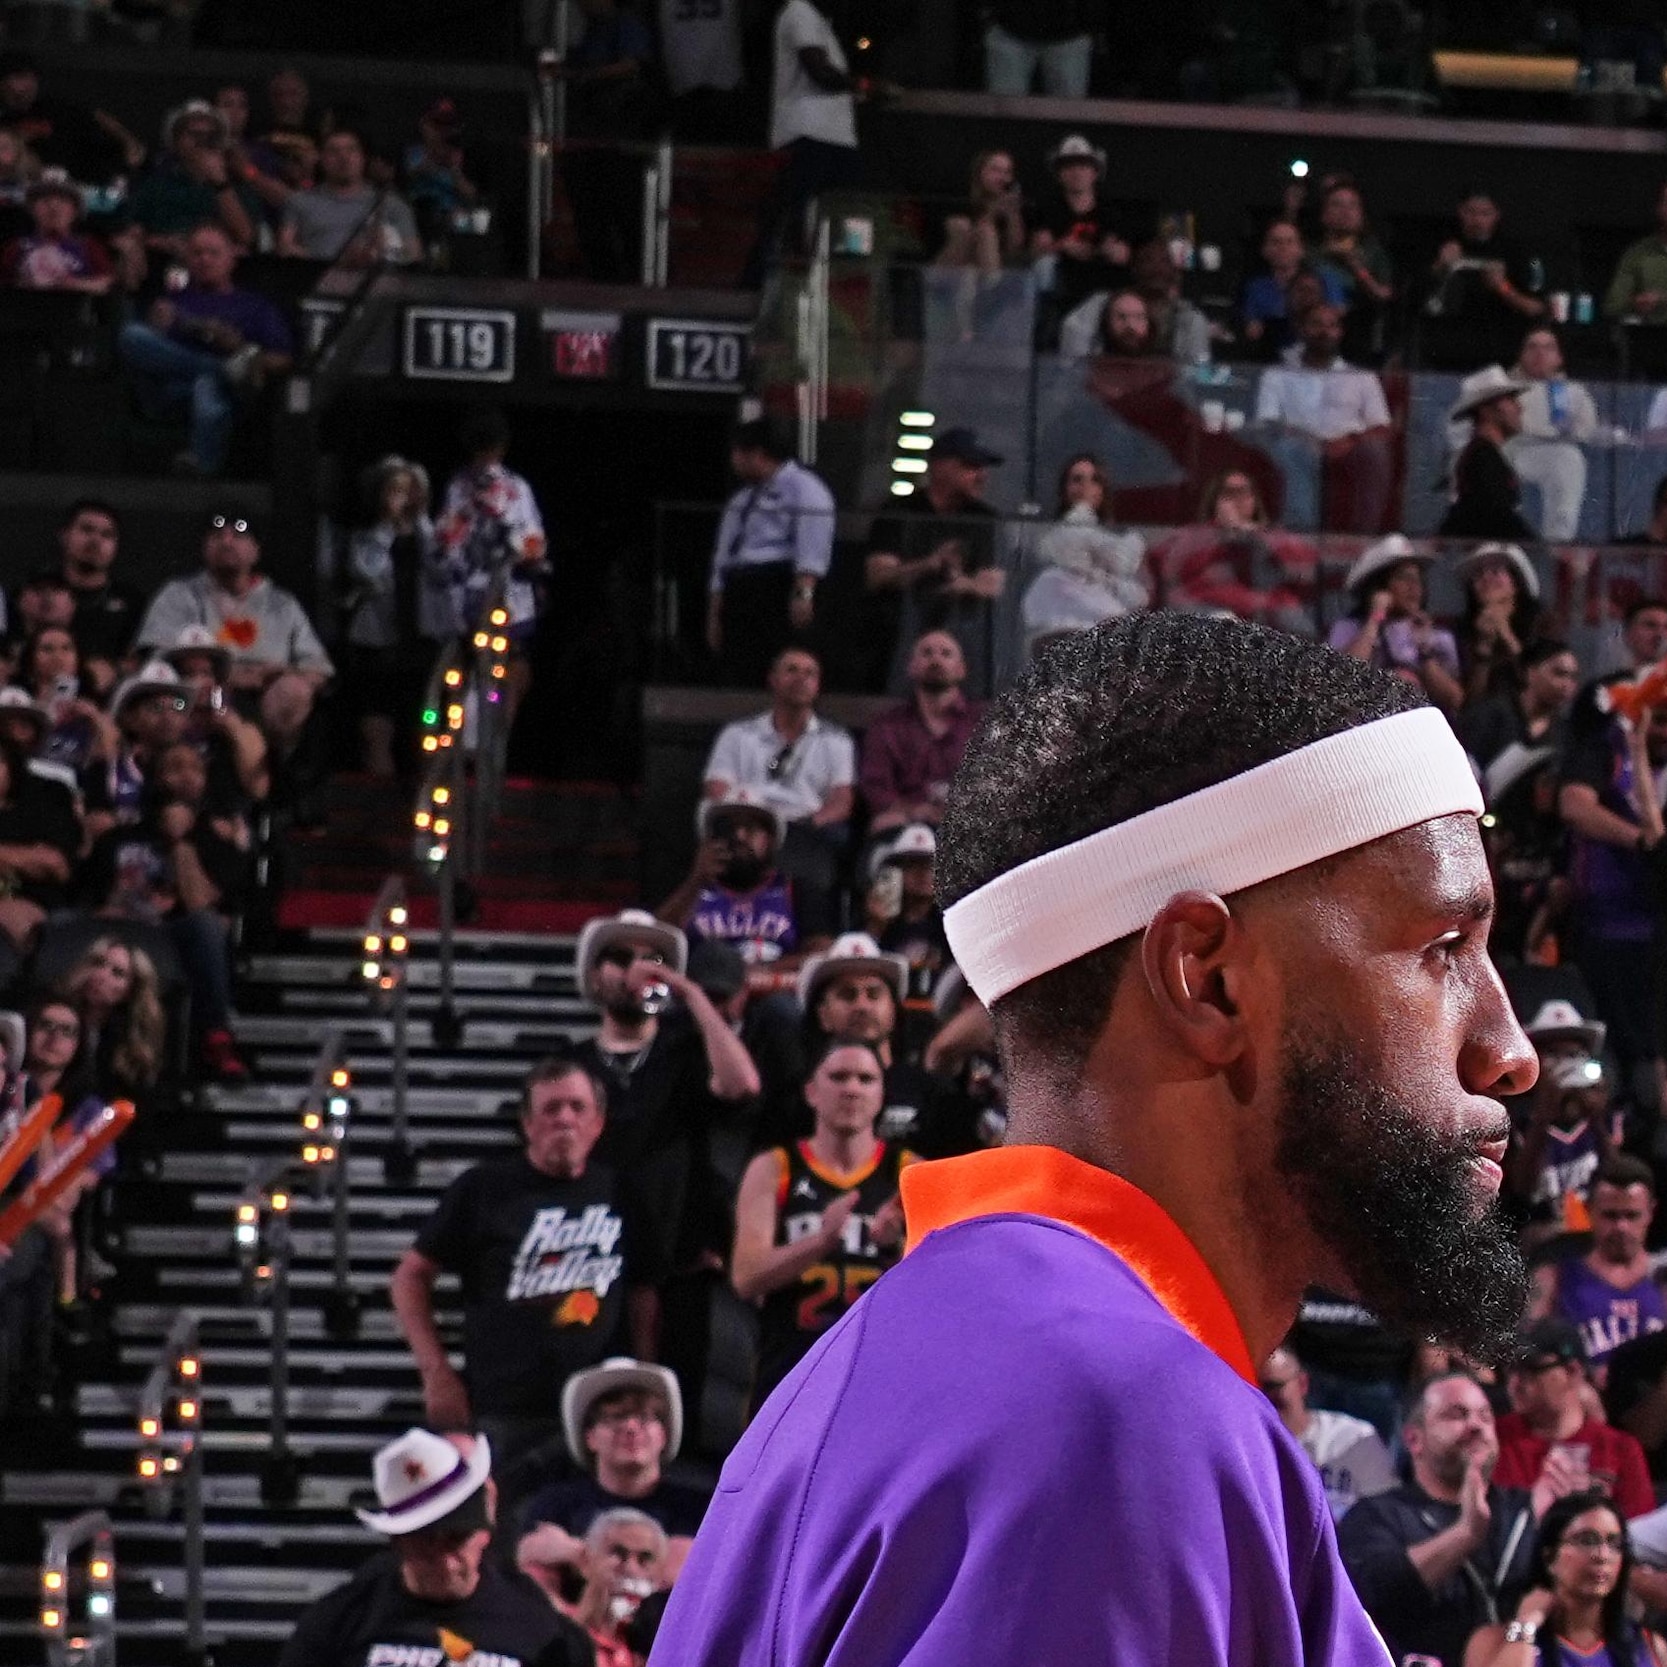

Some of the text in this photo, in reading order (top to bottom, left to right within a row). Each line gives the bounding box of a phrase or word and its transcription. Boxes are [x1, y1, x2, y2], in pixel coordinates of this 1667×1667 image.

[428, 322, 496, 370] 119
[670, 334, 740, 380] 120
[515, 1202, 623, 1257] Rally
[506, 1248, 623, 1301] Valley
